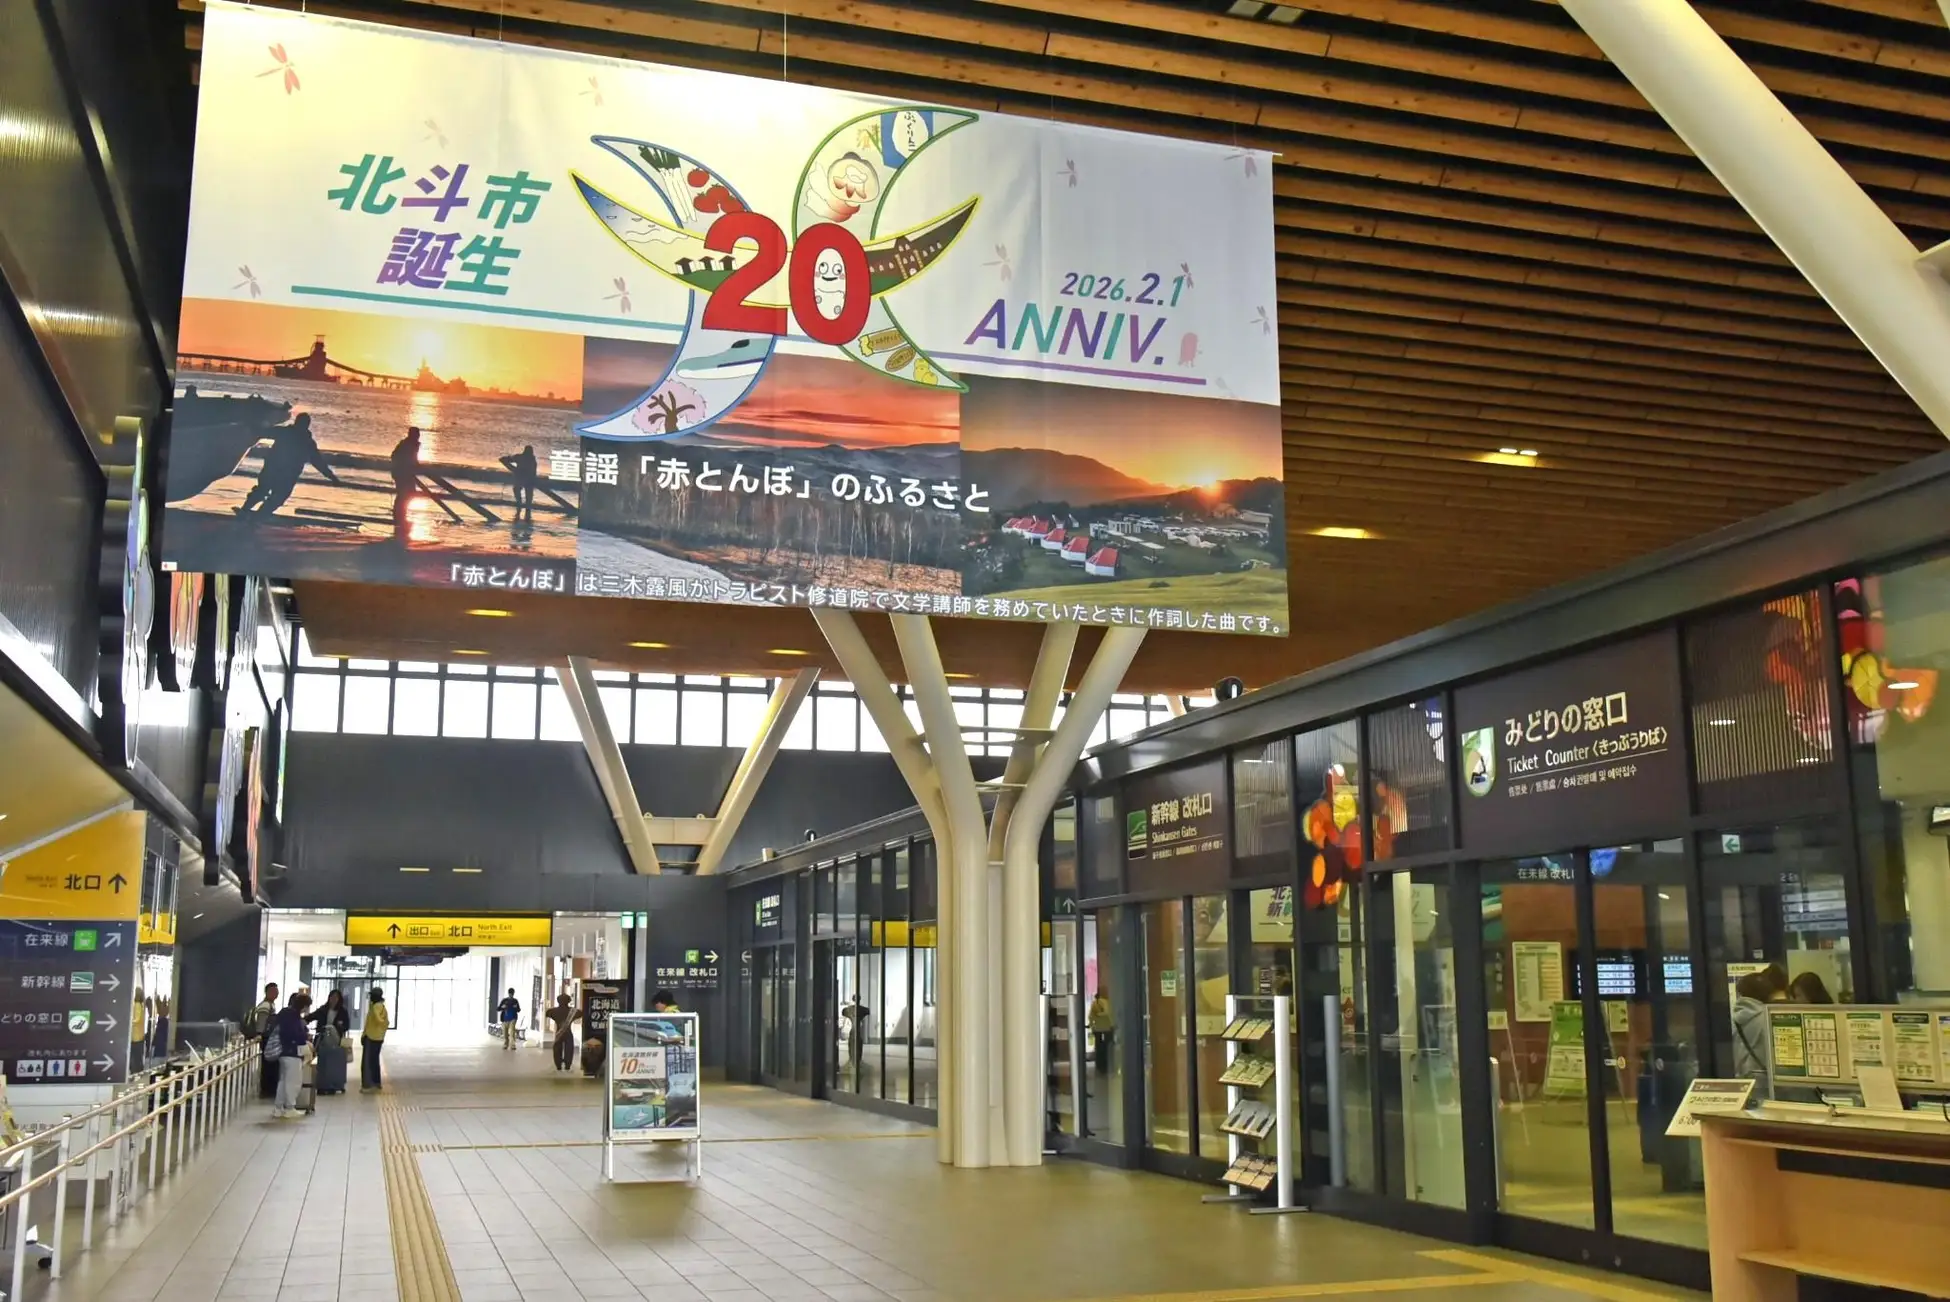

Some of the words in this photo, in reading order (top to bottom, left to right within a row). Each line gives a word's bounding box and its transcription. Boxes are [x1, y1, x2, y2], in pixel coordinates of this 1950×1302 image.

[328, 153, 552, 230] 北斗市
[376, 228, 521, 296] 誕生
[702, 211, 872, 345] 20
[1060, 271, 1186, 308] 2026.2.1
[964, 298, 1166, 366] ANNIV.
[548, 450, 991, 513] 童謡「赤とんぼ」のふるさと
[1505, 692, 1628, 747] みどりの窓口
[1507, 754, 1539, 774] Ticket
[1545, 745, 1589, 767] Counter
[1151, 799, 1180, 826] 新幹線
[1182, 792, 1212, 819] 改札口
[1181, 825, 1198, 838] Gates
[64, 874, 101, 891] 北口
[1550, 868, 1574, 880] 改札
[25, 933, 68, 947] 在来線
[409, 926, 429, 936] 出口
[448, 925, 473, 937] 北口
[21, 975, 66, 989] 新幹線
[689, 968, 718, 977] 改札口
